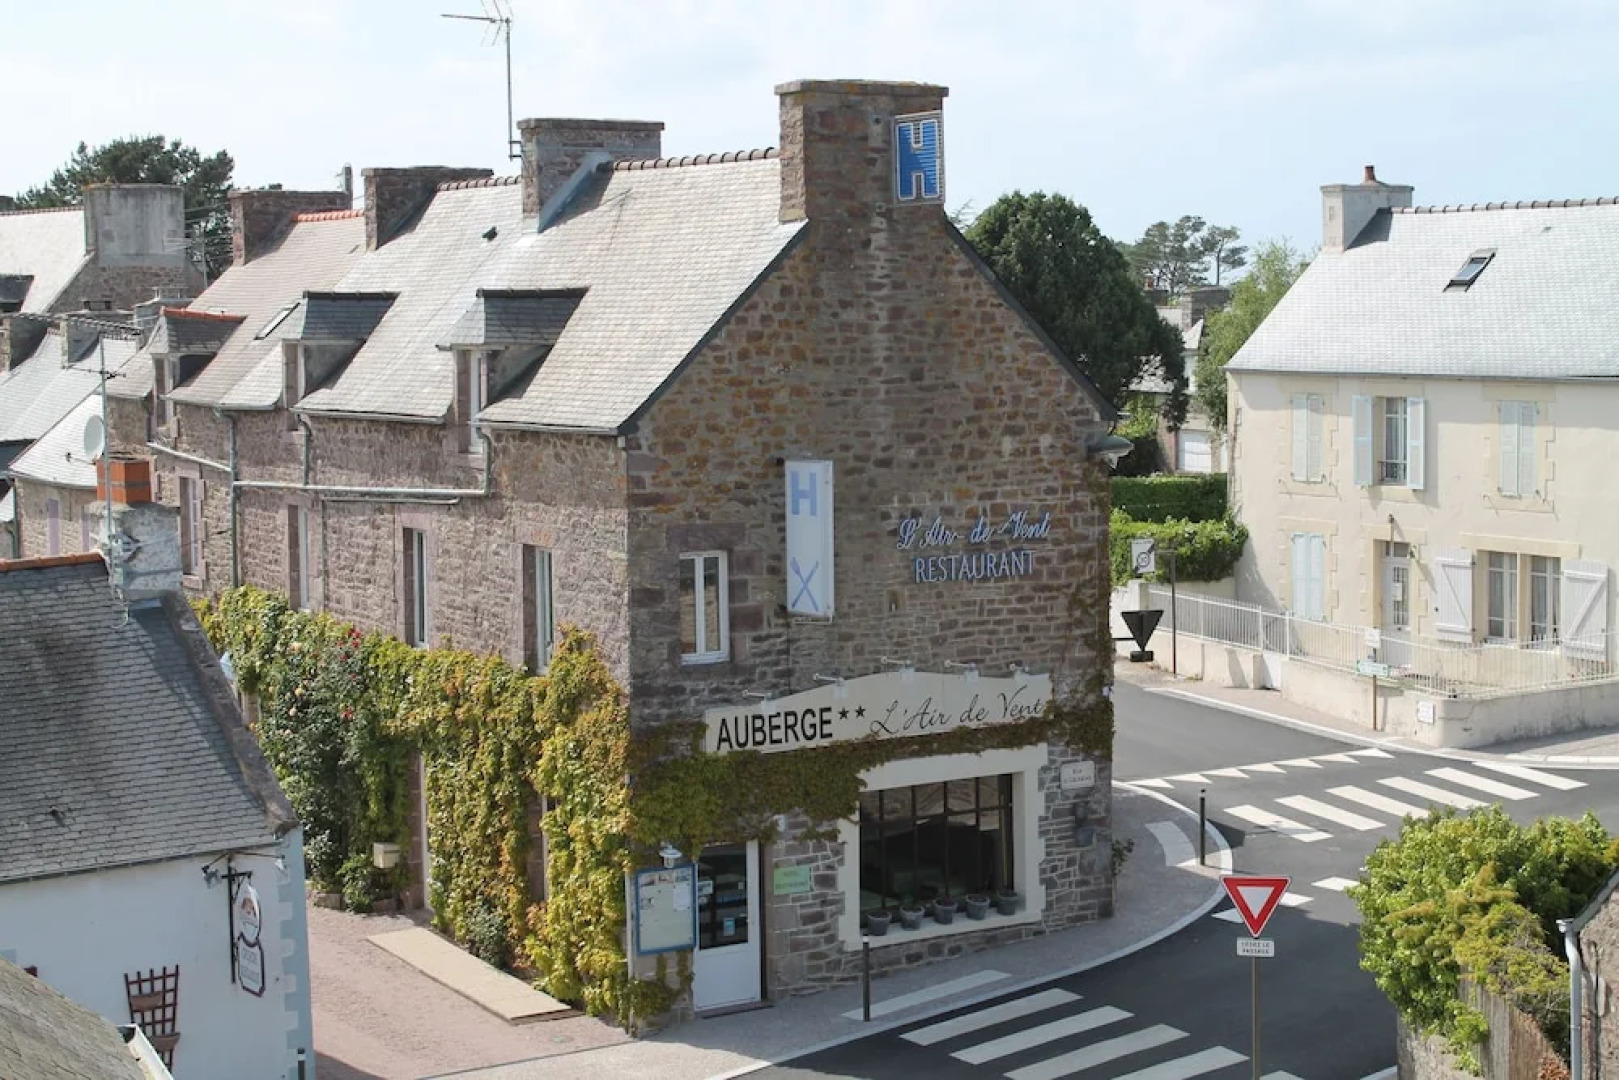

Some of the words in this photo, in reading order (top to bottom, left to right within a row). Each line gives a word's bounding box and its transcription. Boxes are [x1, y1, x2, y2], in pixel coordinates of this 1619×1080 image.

[790, 470, 818, 517] H
[897, 516, 965, 550] L'Air
[970, 515, 994, 544] de
[998, 510, 1050, 539] Vent
[915, 549, 1036, 584] RESTAURANT
[716, 706, 834, 751] AUBERGE
[870, 697, 951, 735] L'Air
[959, 697, 988, 722] de
[997, 685, 1045, 720] Vent
